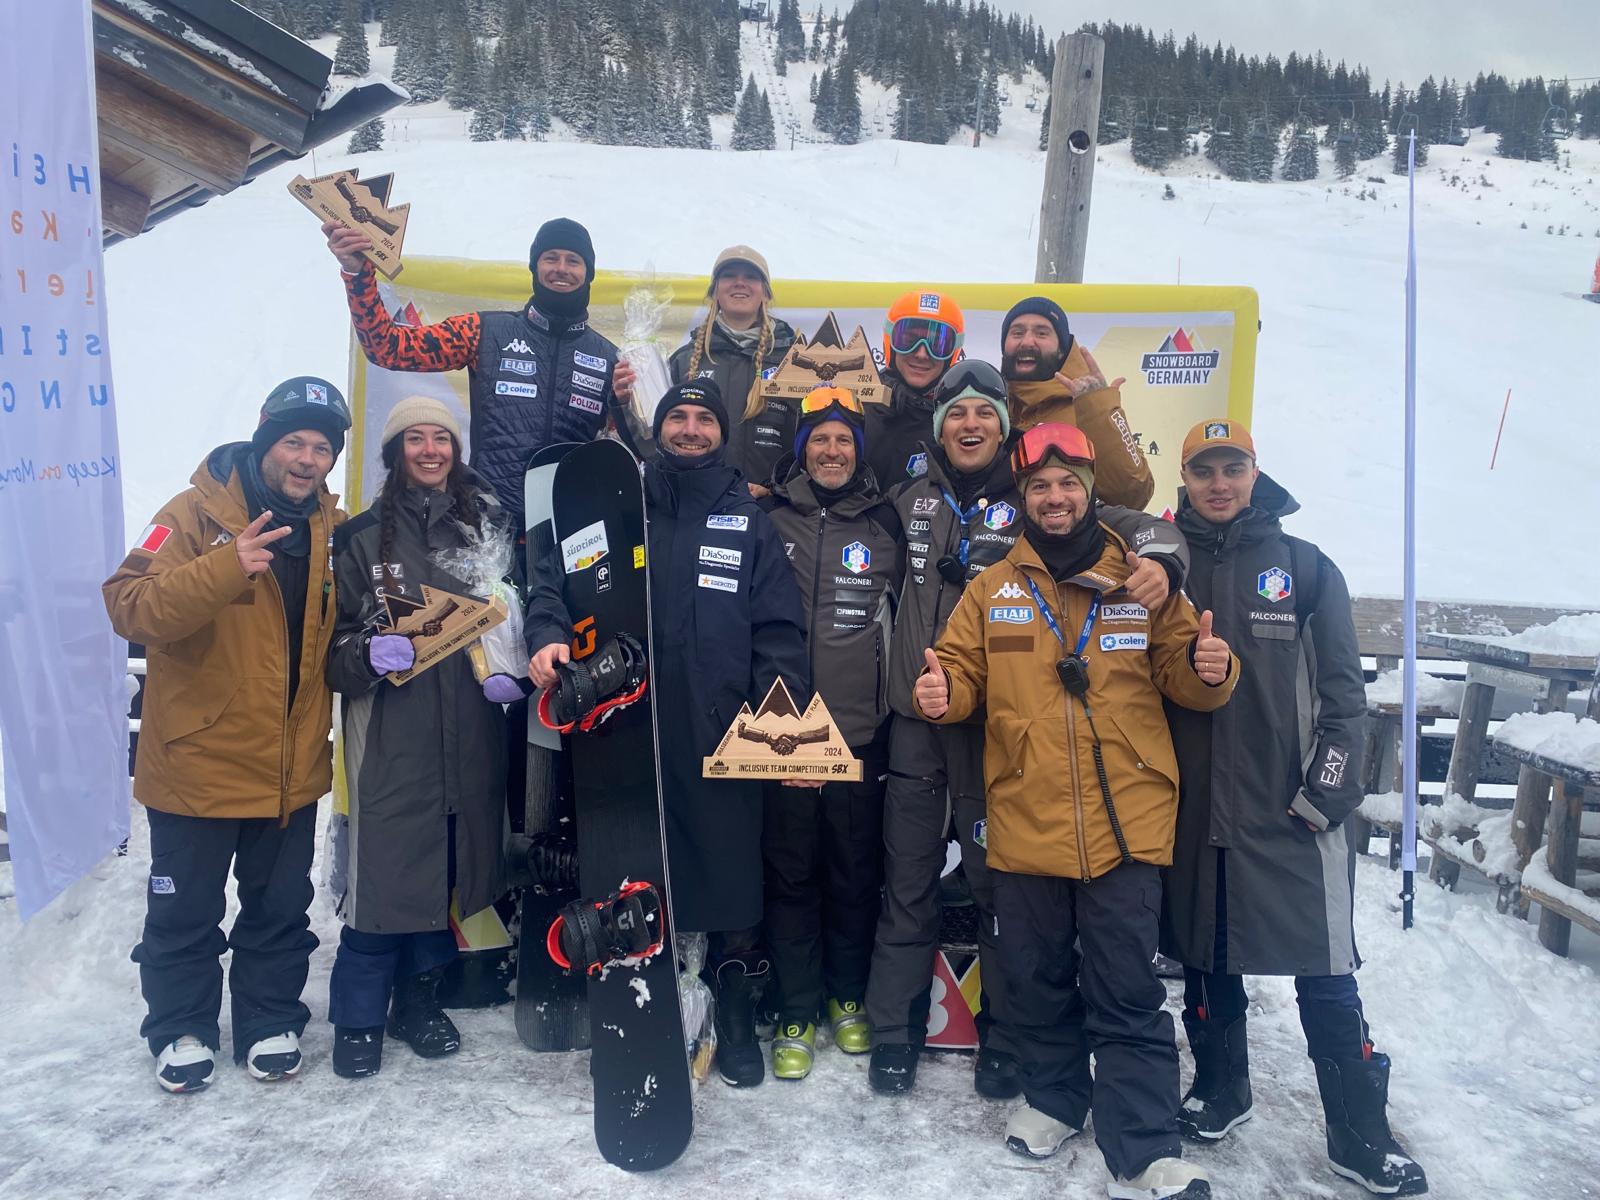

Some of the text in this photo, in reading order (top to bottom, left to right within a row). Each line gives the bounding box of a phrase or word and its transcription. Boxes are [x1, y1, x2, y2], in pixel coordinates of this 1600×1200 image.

[381, 238, 396, 251] 2024
[1149, 355, 1212, 367] SNOWBOARD
[857, 374, 873, 383] 2024
[1147, 370, 1210, 384] GERMANY
[860, 387, 875, 397] SBX
[571, 396, 600, 411] POLIZIA
[1111, 411, 1140, 467] Kappa
[913, 498, 939, 511] EA7
[701, 548, 740, 563] DiaSorin
[835, 576, 872, 586] FALCONERI
[461, 605, 477, 617] 2024
[1103, 605, 1147, 617] DiaSorin
[1251, 611, 1295, 622] FALCONERI
[477, 616, 490, 628] SBX
[1118, 636, 1146, 645] colere
[824, 747, 842, 756] 2024
[738, 763, 849, 774] INCLUSIVE TEAM COMPETITION SBX
[1320, 747, 1343, 785] EA7
